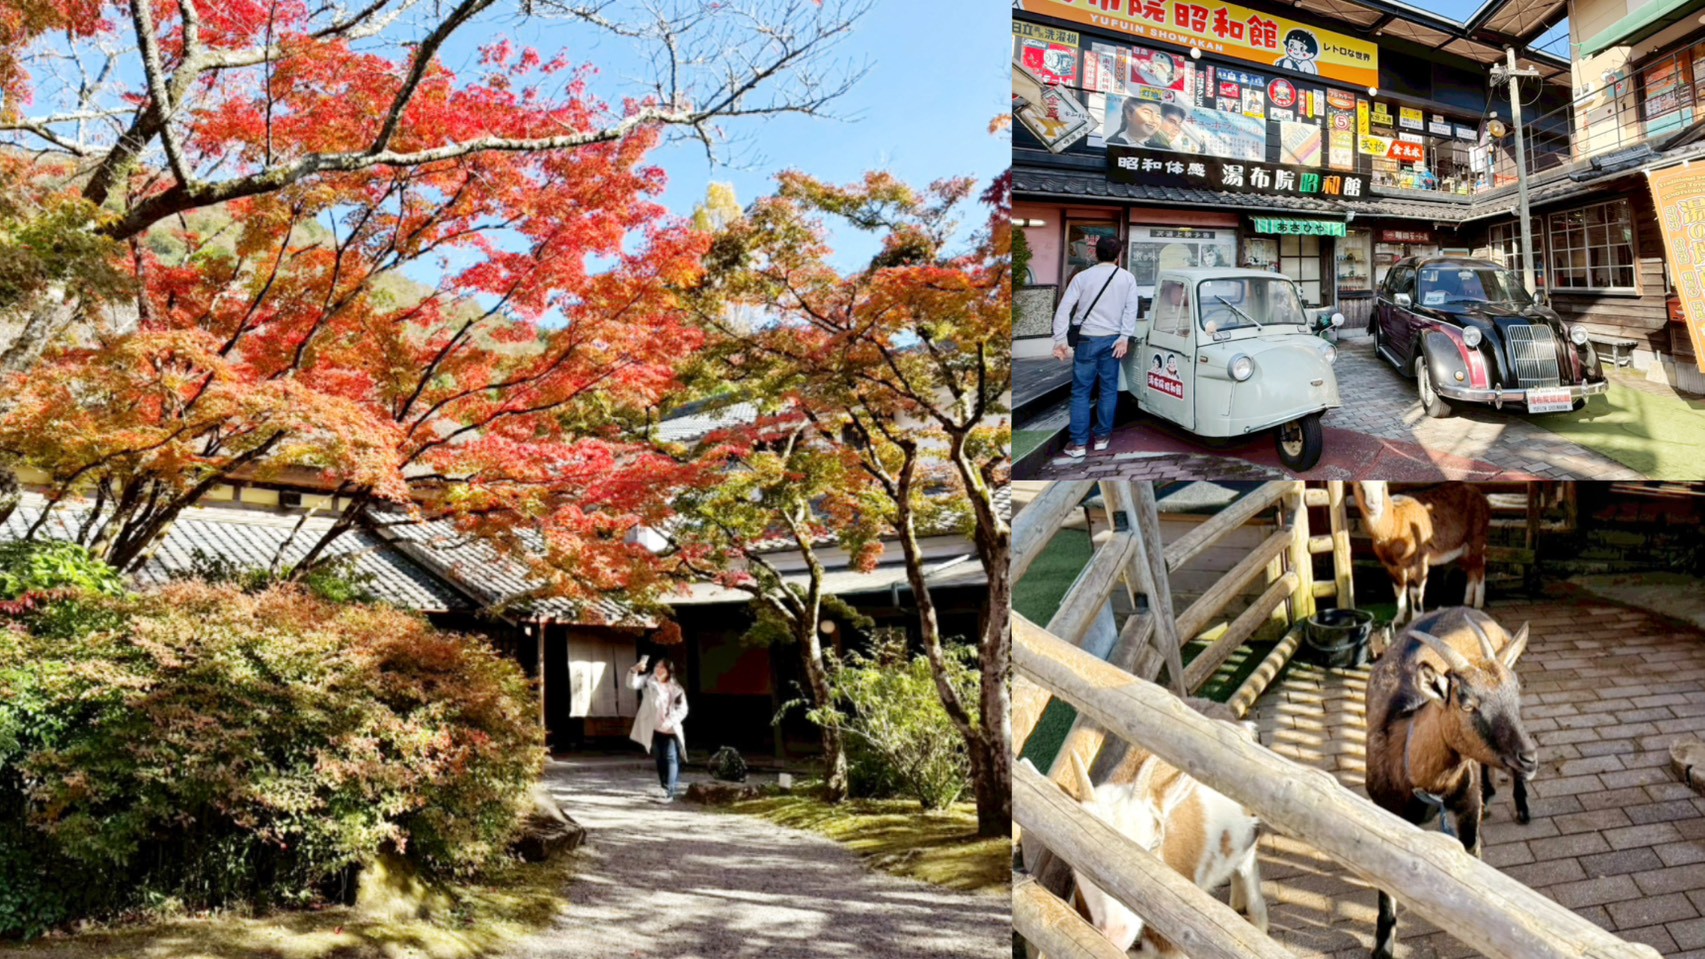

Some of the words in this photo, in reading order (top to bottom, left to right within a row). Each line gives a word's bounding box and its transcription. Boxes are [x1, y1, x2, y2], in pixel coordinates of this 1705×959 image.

[1062, 0, 1277, 49] 院昭和館
[1089, 13, 1145, 34] YUFUIN
[1150, 28, 1224, 52] SHOWAKAN
[1323, 42, 1370, 61] レトロな世界
[1117, 156, 1206, 178] 昭和体感
[1221, 163, 1363, 198] 湯布院昭和館
